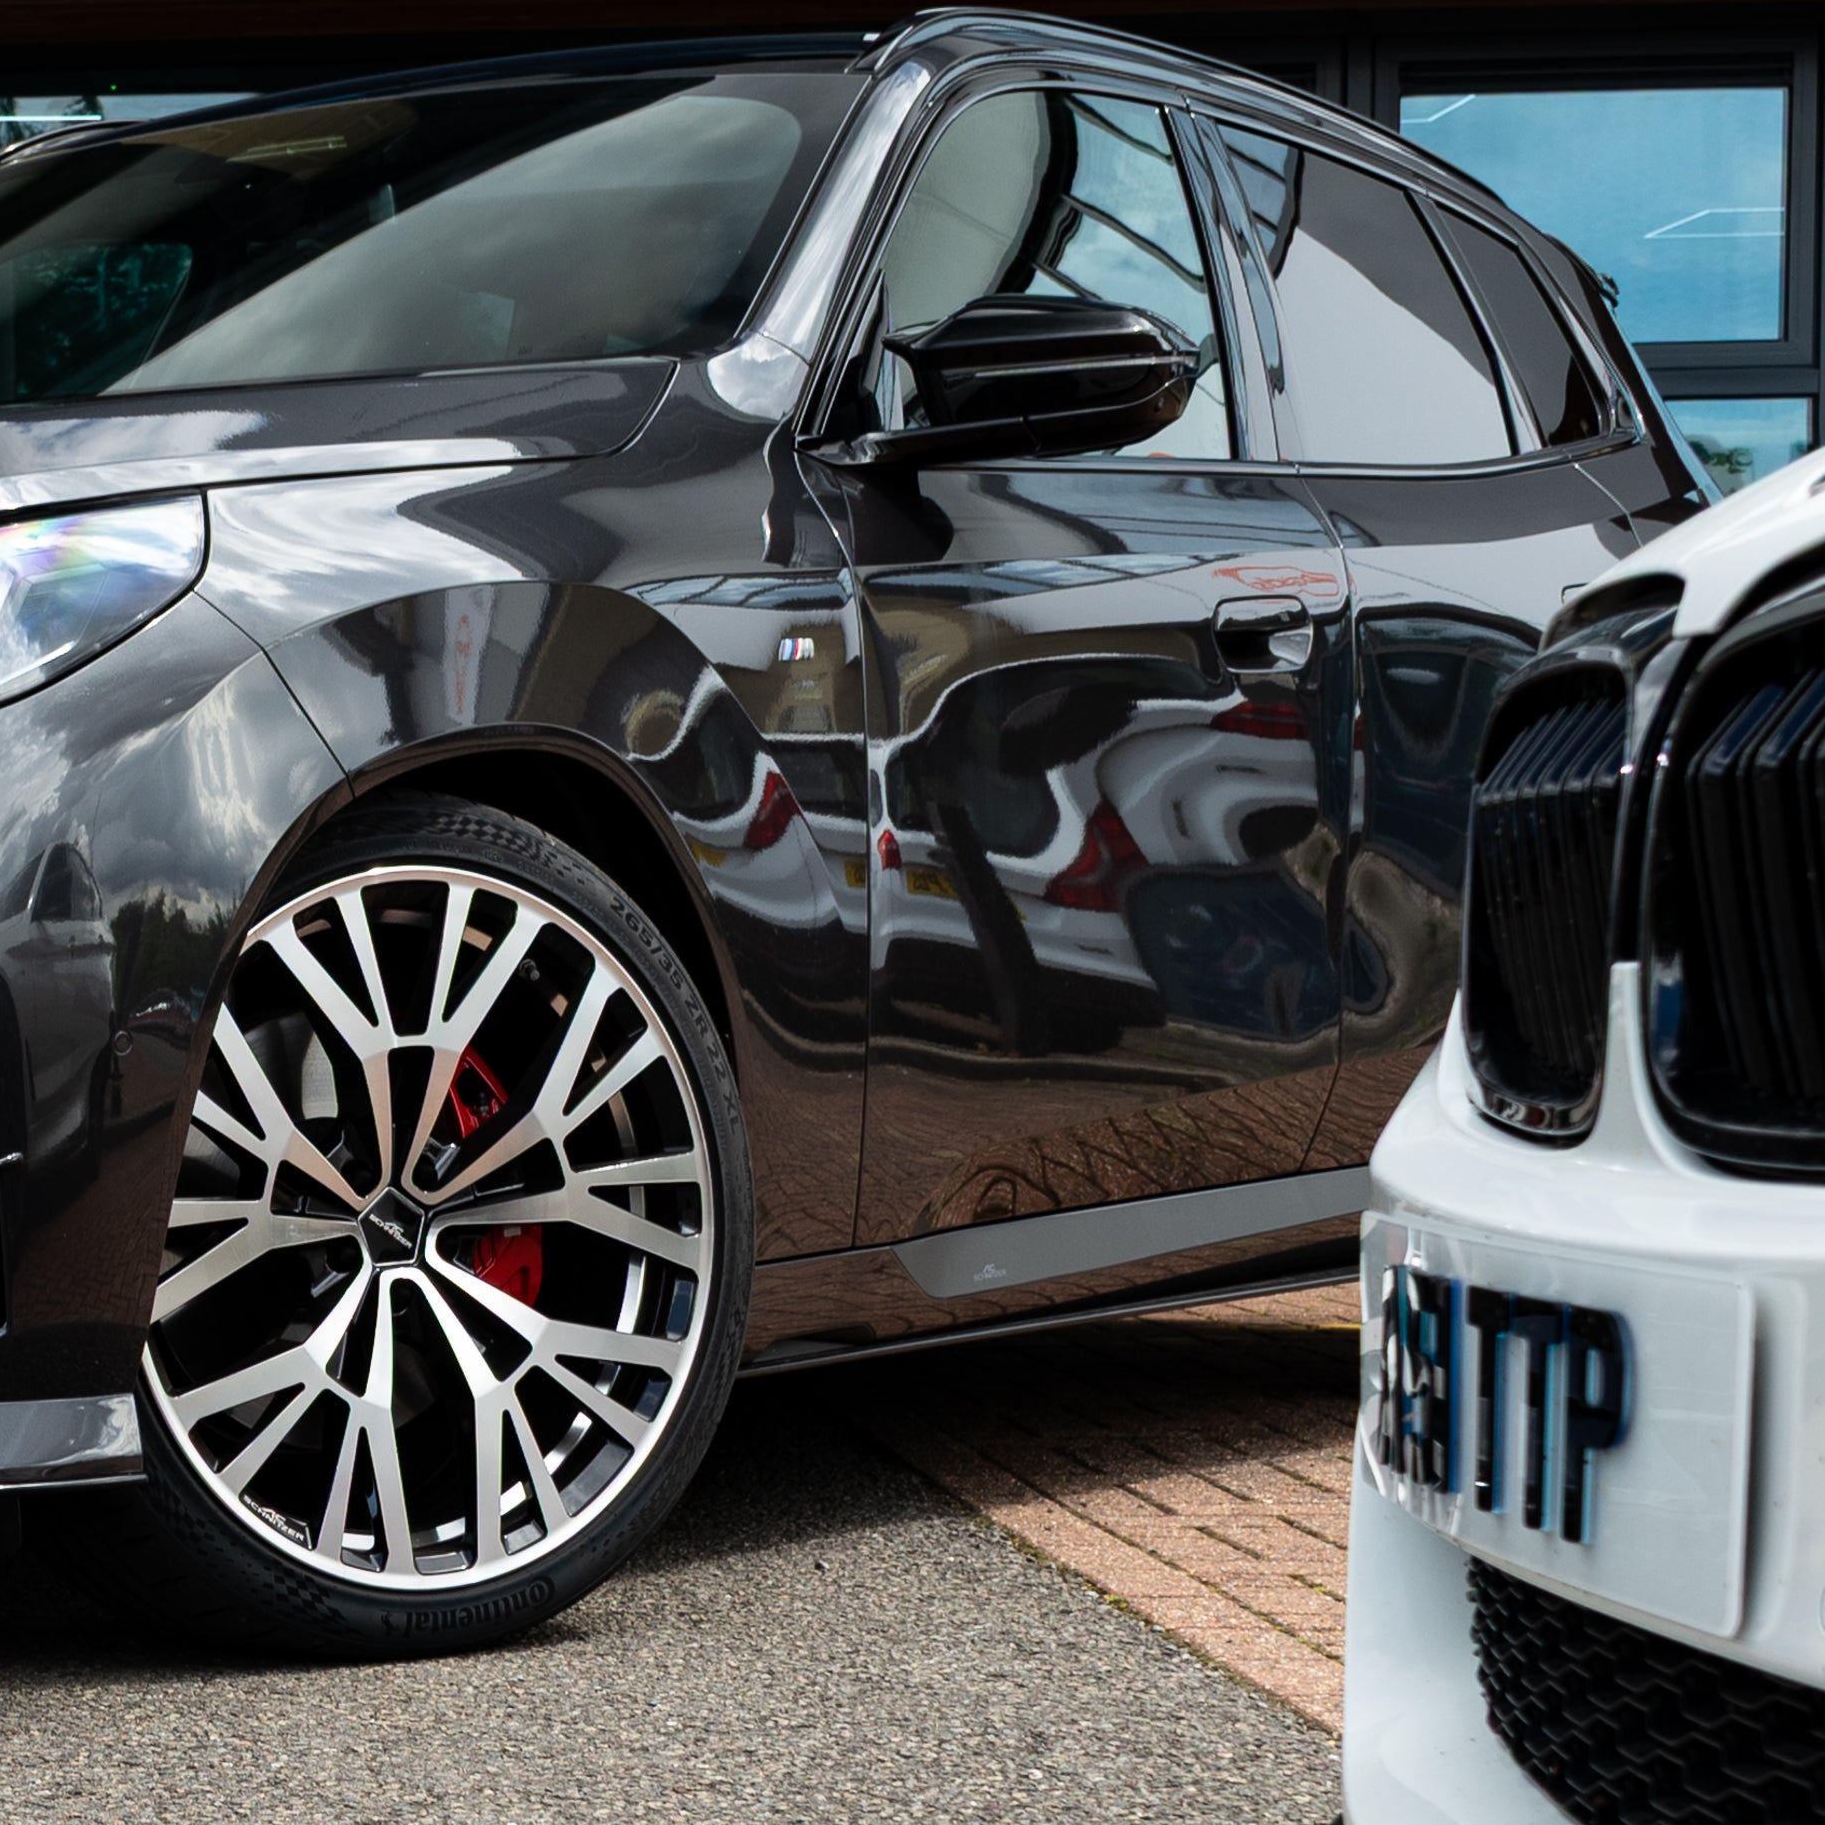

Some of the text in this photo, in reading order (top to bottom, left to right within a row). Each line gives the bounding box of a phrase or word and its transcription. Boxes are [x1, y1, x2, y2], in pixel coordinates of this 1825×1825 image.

[609, 896, 740, 1135] 265/35 ZR 22 XL
[243, 1494, 306, 1542] SCHNITZER
[403, 1576, 556, 1639] Continental
